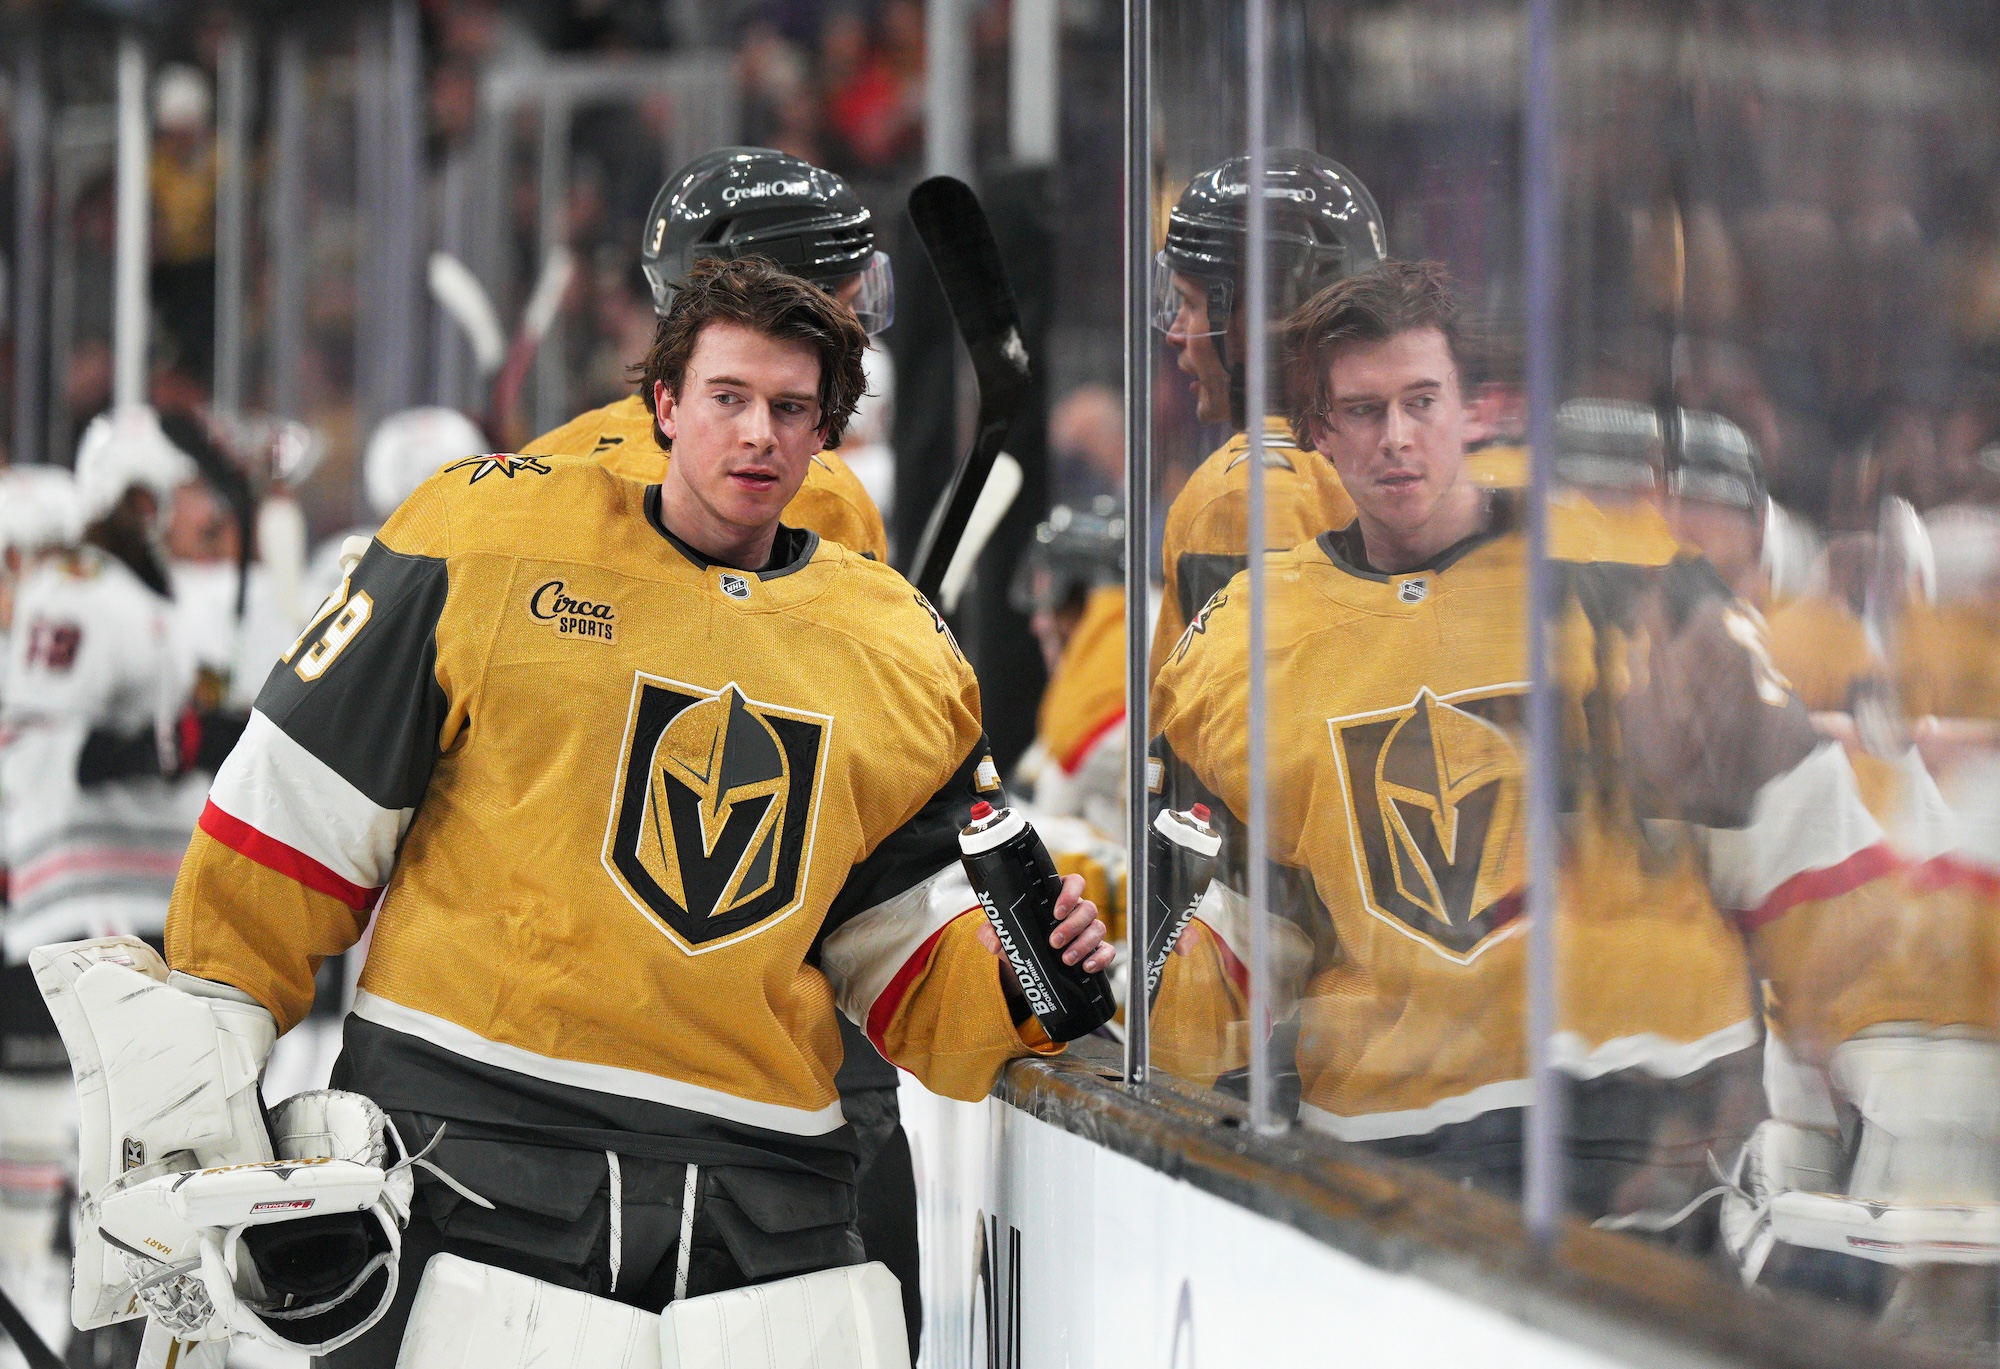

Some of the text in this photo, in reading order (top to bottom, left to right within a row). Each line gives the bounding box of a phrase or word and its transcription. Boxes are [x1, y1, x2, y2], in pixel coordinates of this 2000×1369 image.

[652, 218, 667, 251] 3
[530, 580, 615, 620] Circa
[726, 580, 745, 593] NHL
[559, 617, 613, 640] SPORTS
[977, 890, 1050, 1017] BODYARMOR
[1025, 957, 1057, 1012] SPORTS DRINK
[143, 1237, 173, 1255] HART
